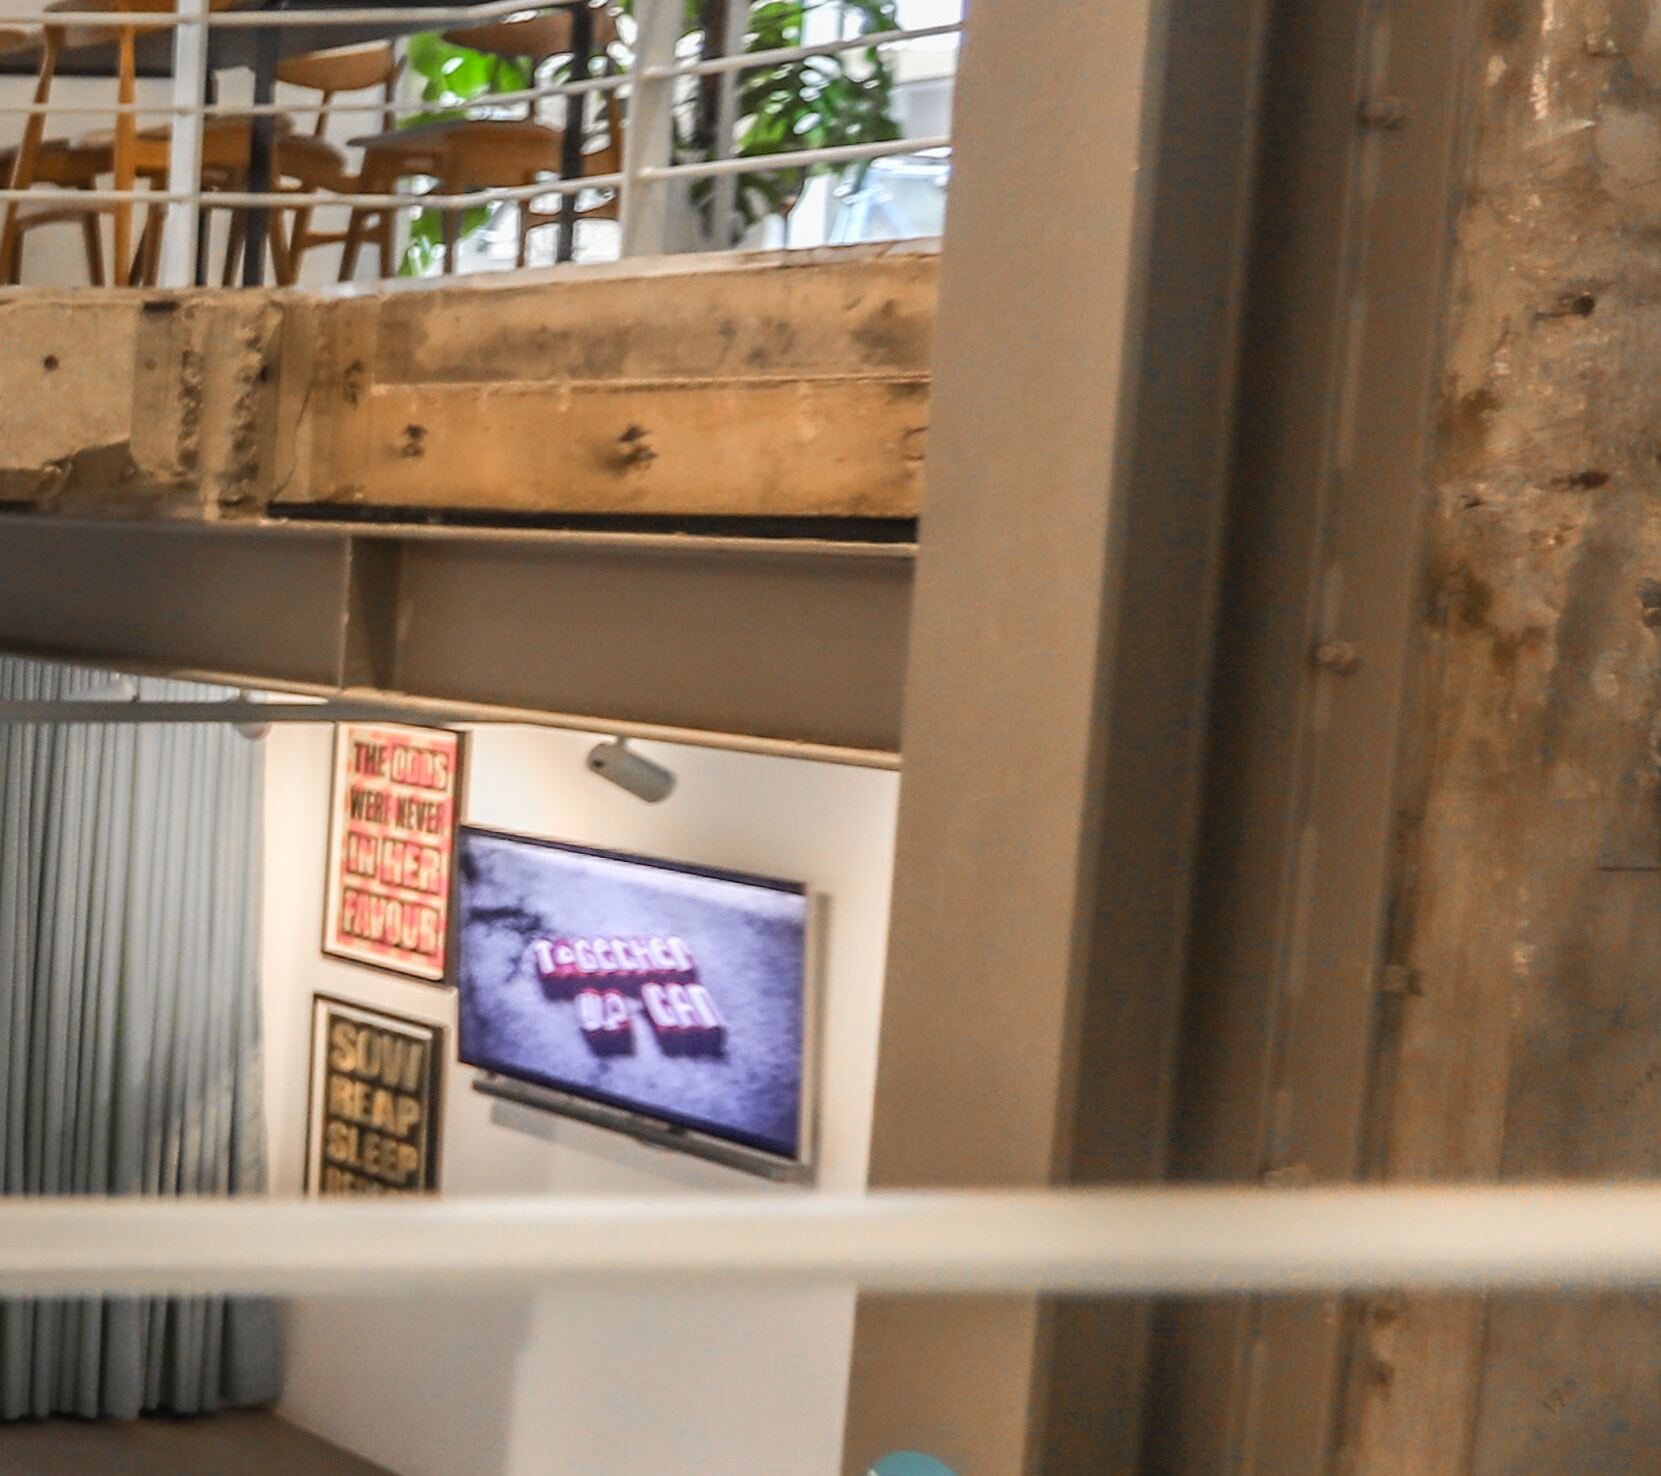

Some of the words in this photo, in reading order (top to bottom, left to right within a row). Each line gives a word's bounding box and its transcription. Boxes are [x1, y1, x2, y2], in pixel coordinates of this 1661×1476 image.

[354, 741, 389, 777] THE
[392, 746, 449, 790] ODDS
[350, 785, 393, 823] WERE
[396, 794, 447, 835] NEVER
[380, 838, 442, 896] HER
[342, 886, 441, 957] FAVOUR
